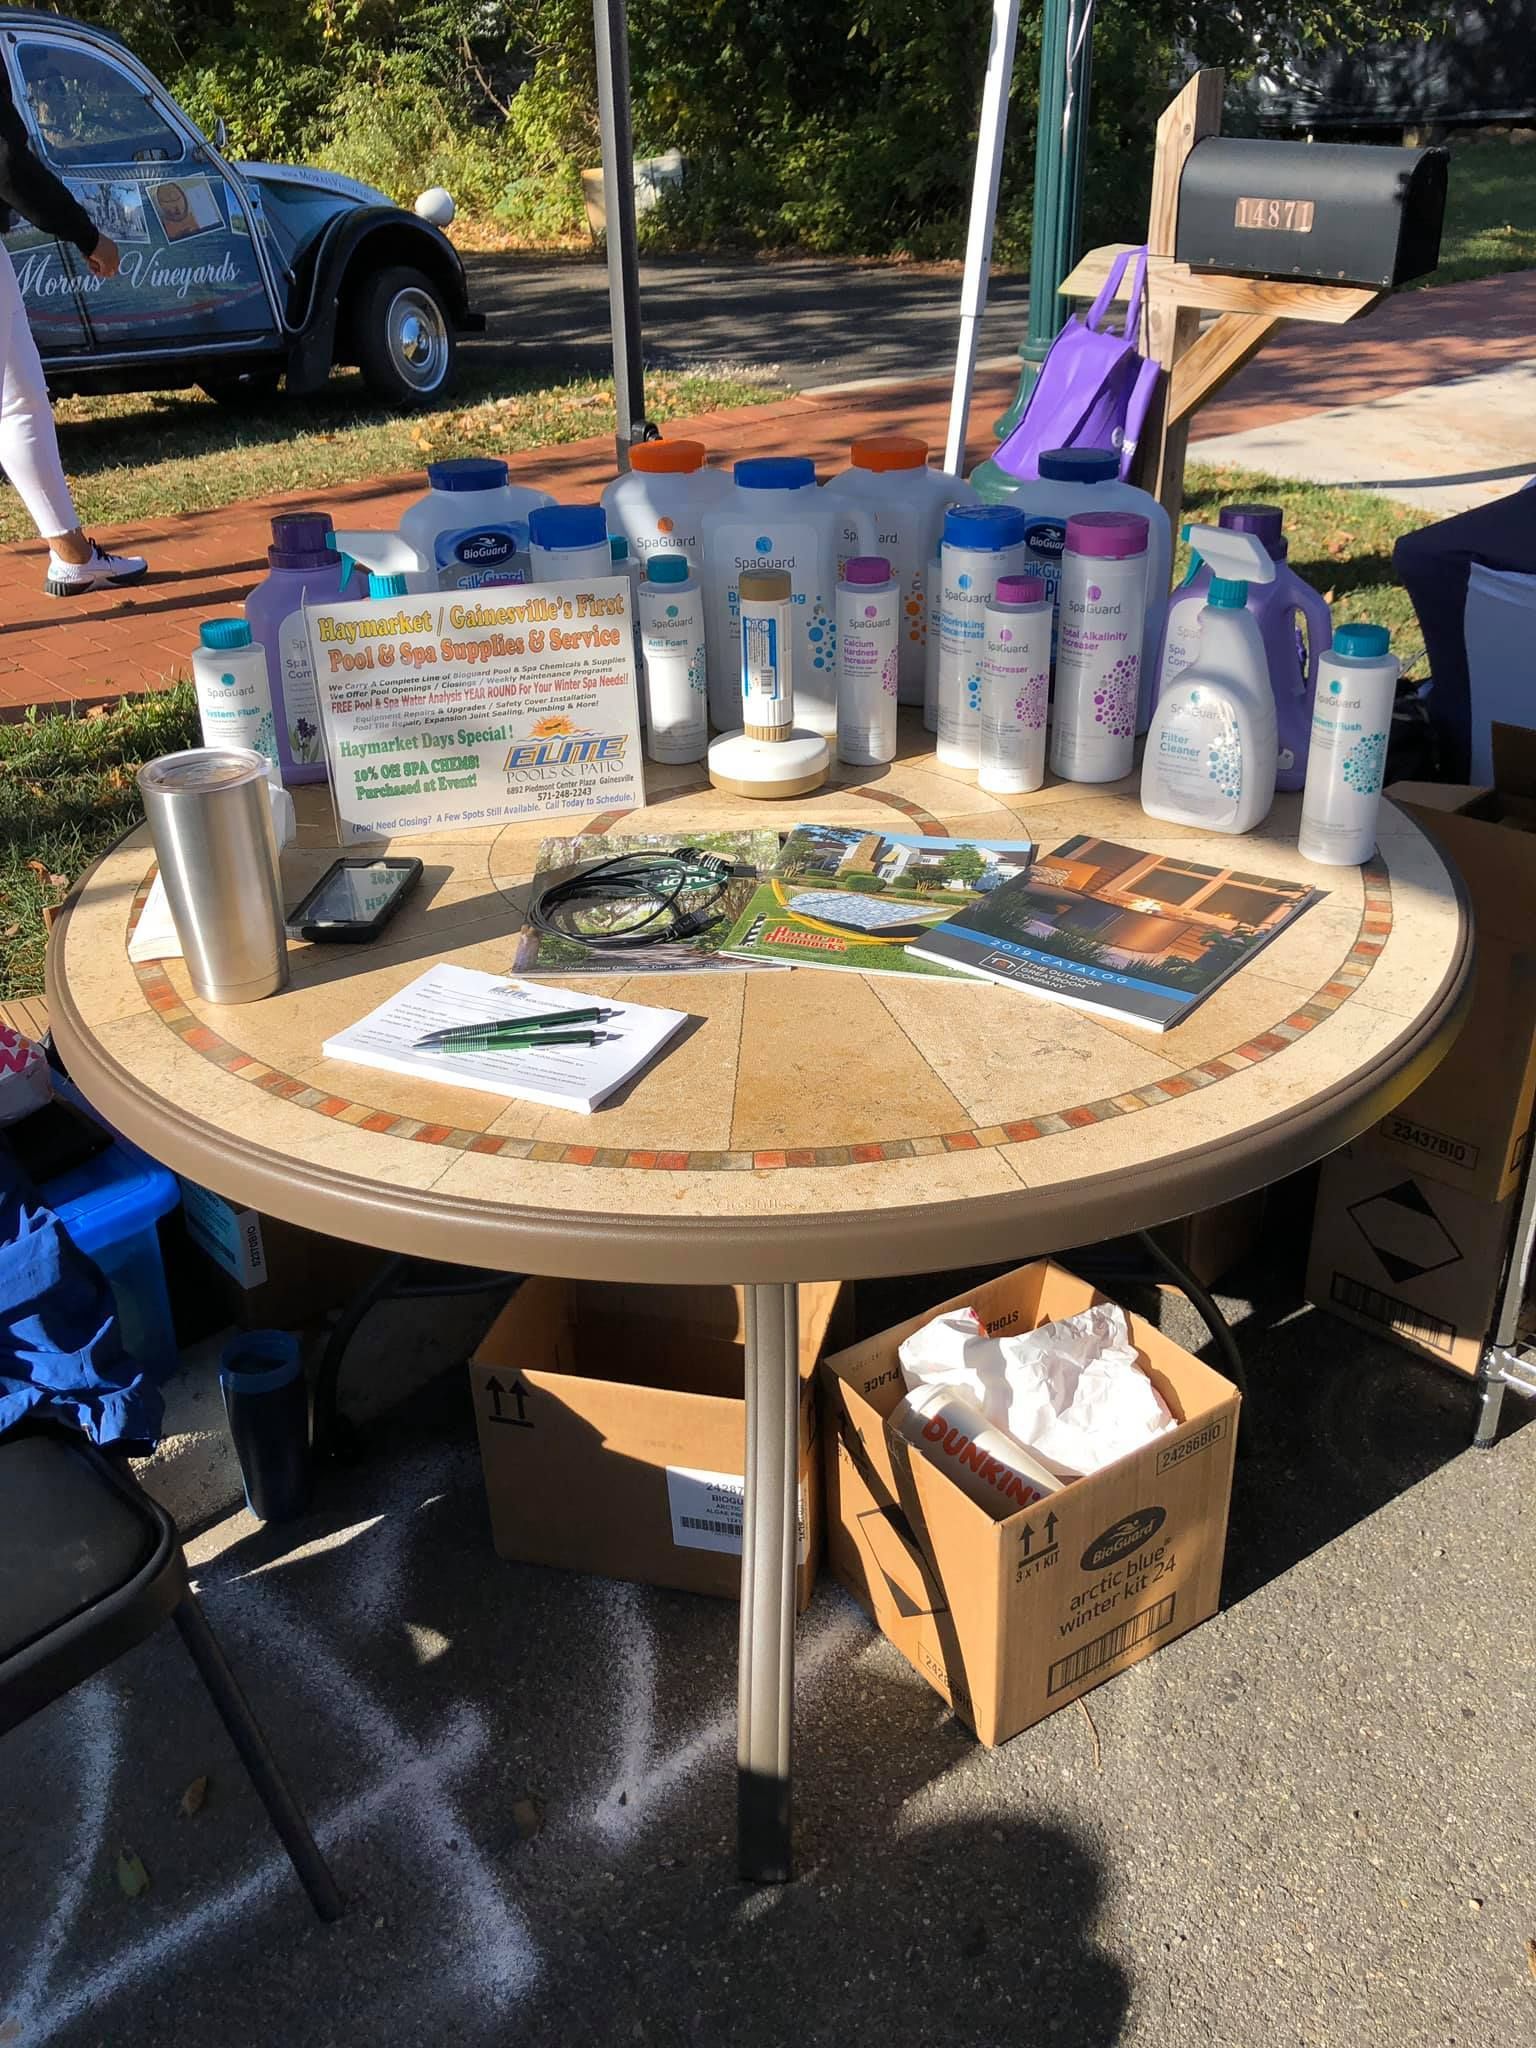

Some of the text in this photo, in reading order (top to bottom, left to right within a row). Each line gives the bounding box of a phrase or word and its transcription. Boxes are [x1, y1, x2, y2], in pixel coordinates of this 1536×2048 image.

[1239, 200, 1312, 229] 14871
[119, 248, 241, 298] Vineyards
[636, 536, 696, 549] SpaGuard
[843, 528, 898, 544] Spard
[1030, 536, 1065, 550] BioGuar
[463, 543, 508, 560] BioGuard
[734, 557, 796, 570] SpaGuard
[945, 587, 992, 604] SpaGuard
[1069, 600, 1121, 615] SpaGuard
[318, 593, 625, 644] Haymarket / Gainesville's First
[652, 616, 693, 629] SpaGuard
[849, 617, 891, 630] SpaGuard
[648, 638, 688, 647] Anti Foam
[844, 638, 874, 648] Calcium
[1082, 631, 1128, 642] Alkalinity
[328, 646, 374, 672] Pool
[378, 644, 395, 667] &
[400, 642, 437, 669] Spa
[440, 633, 525, 663] Supplies
[529, 629, 544, 653] &
[550, 625, 621, 650] Service
[844, 648, 878, 657] Hardness
[988, 641, 1029, 654] SpaGuard
[1168, 644, 1186, 656] Spa
[286, 659, 308, 669] Spa
[844, 656, 878, 665] Increaser
[992, 663, 1029, 674] Increaser
[329, 685, 342, 693] We
[345, 682, 368, 691] Carry
[380, 677, 420, 687] Complete
[453, 669, 491, 680] Bioguard
[522, 665, 537, 673] Spa
[540, 661, 581, 671] Chemicals
[592, 657, 626, 666] Supplies
[371, 688, 389, 696] Pool
[392, 684, 431, 695] Openings
[442, 680, 476, 690] Closings
[487, 675, 517, 685] Weekly
[519, 671, 571, 681] Maintenance
[573, 667, 613, 677] Programs
[207, 684, 256, 698] SpaGuard
[332, 673, 629, 713] FREE Pool & Spa Water Analysis YEAR ROUND For Your Winter Spa Needs!!
[238, 706, 260, 717] Flush
[353, 724, 372, 732] Pool
[375, 722, 390, 730] Tile
[425, 715, 467, 725] Expansion
[470, 712, 489, 720] Joint
[527, 703, 565, 713] Plumbing
[576, 700, 600, 708] More!
[356, 714, 401, 724] Equipment
[404, 710, 435, 719] Repairs
[447, 704, 486, 715] Upgrades
[496, 700, 522, 709] Safety
[550, 693, 596, 703] Installation
[1171, 703, 1225, 721] SpaGuard
[339, 727, 507, 758] Haymarket Days Special
[1160, 731, 1189, 745] Filter
[503, 735, 628, 771] ELITE
[1160, 742, 1201, 756] Cleaner
[354, 766, 378, 783] 10%
[403, 759, 430, 777] SPA
[431, 755, 480, 774] CHEMS!
[507, 760, 624, 783] POOLS & PATIO
[356, 774, 478, 800] Purchased at Event!
[506, 775, 634, 795] 6892 Piedmont Center Plaza Gainesville
[537, 787, 592, 801] 571-248-2243
[376, 819, 397, 830] Need
[399, 816, 432, 830] Closing?
[437, 814, 443, 823] A
[445, 812, 460, 822] Few
[463, 809, 485, 820] Spots
[487, 807, 502, 817] Still
[504, 804, 541, 815] Available.
[545, 801, 560, 810] Call
[562, 797, 585, 808] Today
[587, 796, 594, 805] to
[763, 933, 848, 951] Hammocks
[775, 925, 845, 944] Hatteras
[989, 939, 1033, 957] 2019
[1040, 955, 1130, 984] CATALOG
[1015, 971, 1067, 989] COMPANY
[1021, 967, 1087, 989] GREATROOM
[1027, 962, 1049, 972] THE
[1049, 969, 1103, 988] OUTDOOR
[1393, 1121, 1465, 1160] 23437BIO
[864, 1310, 1019, 1393] STORE PLACE
[1162, 1424, 1221, 1468] 24286BIO
[706, 1481, 744, 1495] 24287
[711, 1494, 744, 1506] BIOGU
[1092, 1517, 1157, 1564] BioGuard
[1016, 1551, 1060, 1583] 3 x 1 KIT
[1070, 1545, 1165, 1611] arctic blue
[1060, 1554, 1176, 1636] winter kit 24
